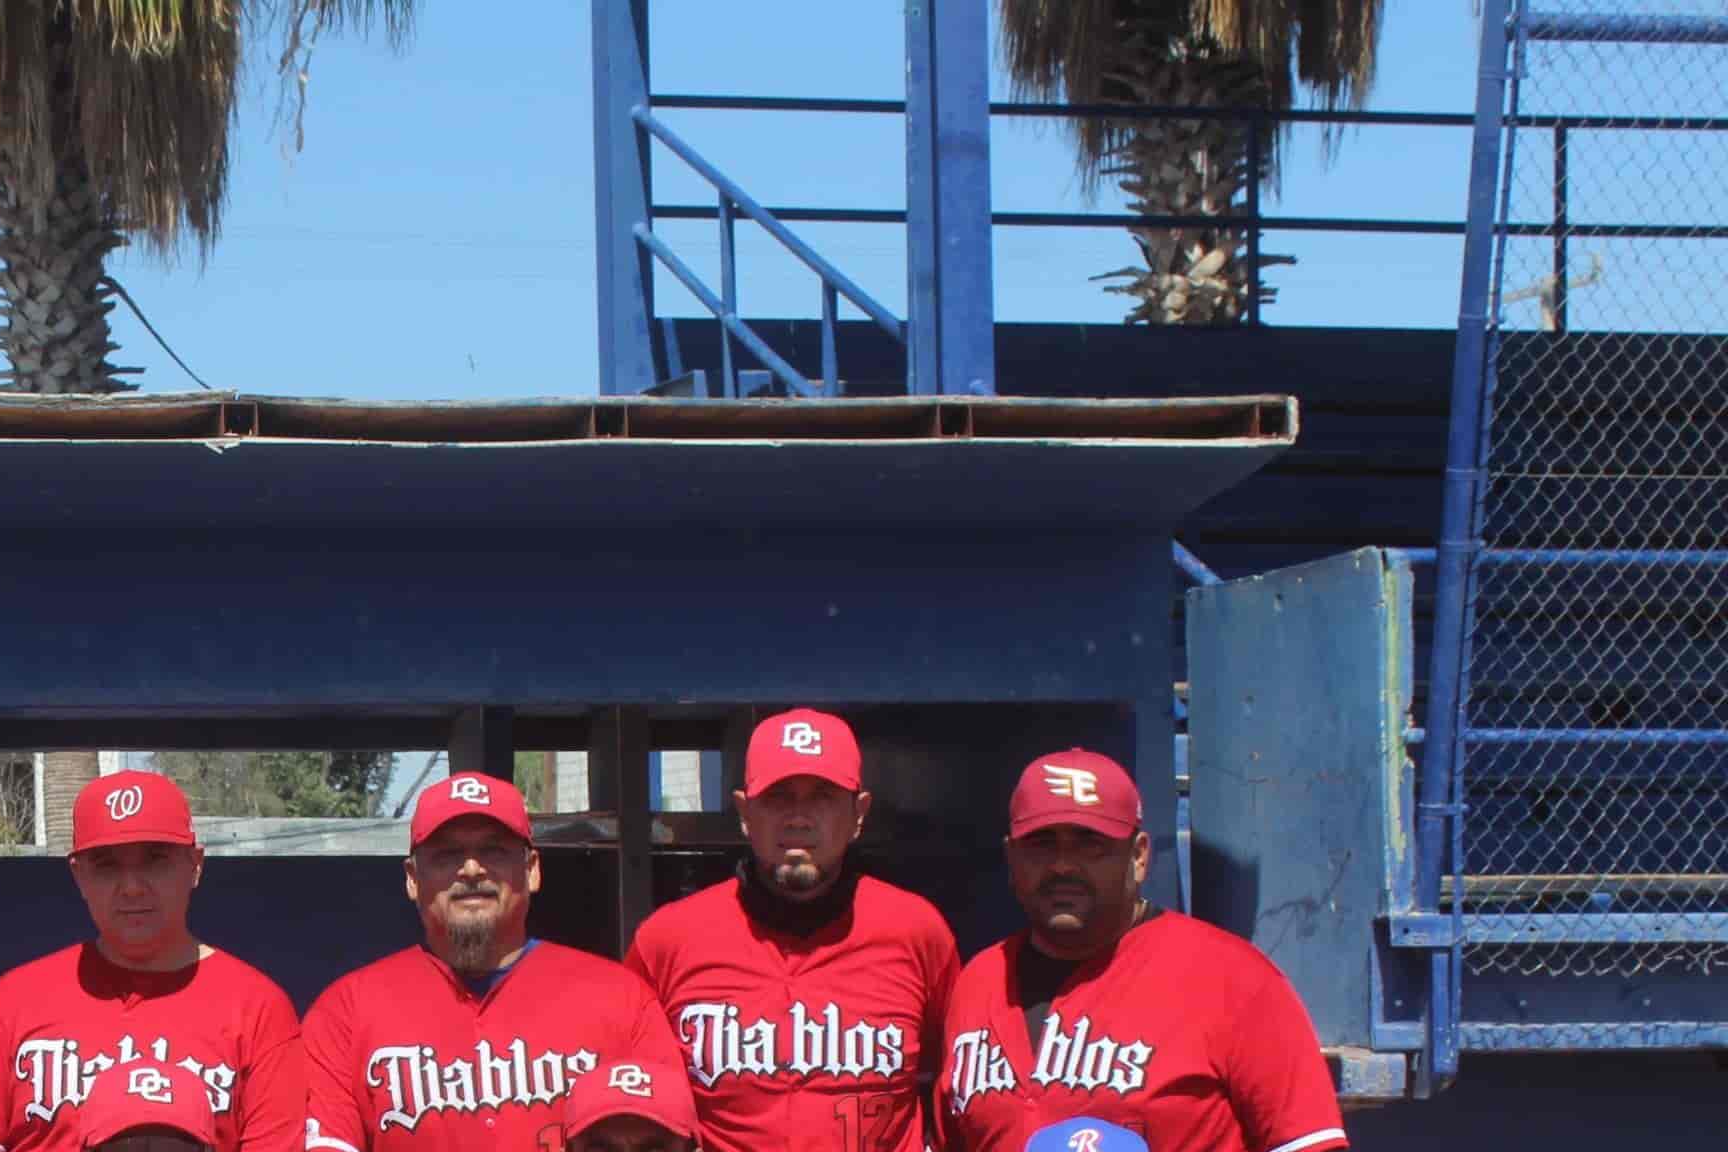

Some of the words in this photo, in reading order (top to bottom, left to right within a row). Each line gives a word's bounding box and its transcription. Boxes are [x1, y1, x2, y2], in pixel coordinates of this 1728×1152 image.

[782, 722, 822, 755] DC
[105, 785, 143, 821] W
[450, 777, 490, 805] DC
[679, 1000, 905, 1089] Diablos
[608, 1064, 651, 1097] DC
[951, 1012, 1154, 1115] Diablos
[128, 1068, 173, 1104] DC
